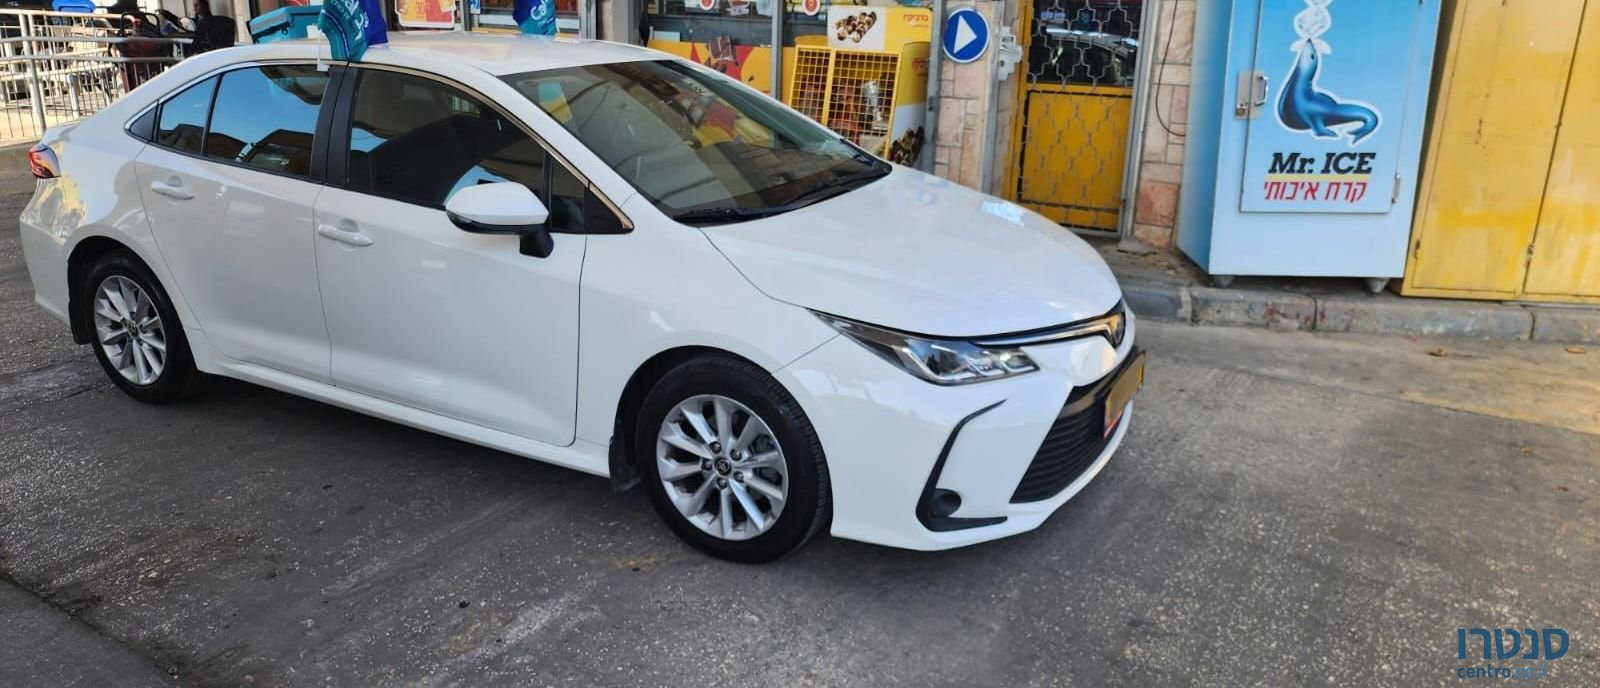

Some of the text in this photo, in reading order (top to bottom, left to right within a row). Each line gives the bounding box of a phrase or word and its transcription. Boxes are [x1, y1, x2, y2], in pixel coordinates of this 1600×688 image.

[1268, 152, 1376, 174] Mr. ICE
[1264, 182, 1368, 203] קרח איכותי
